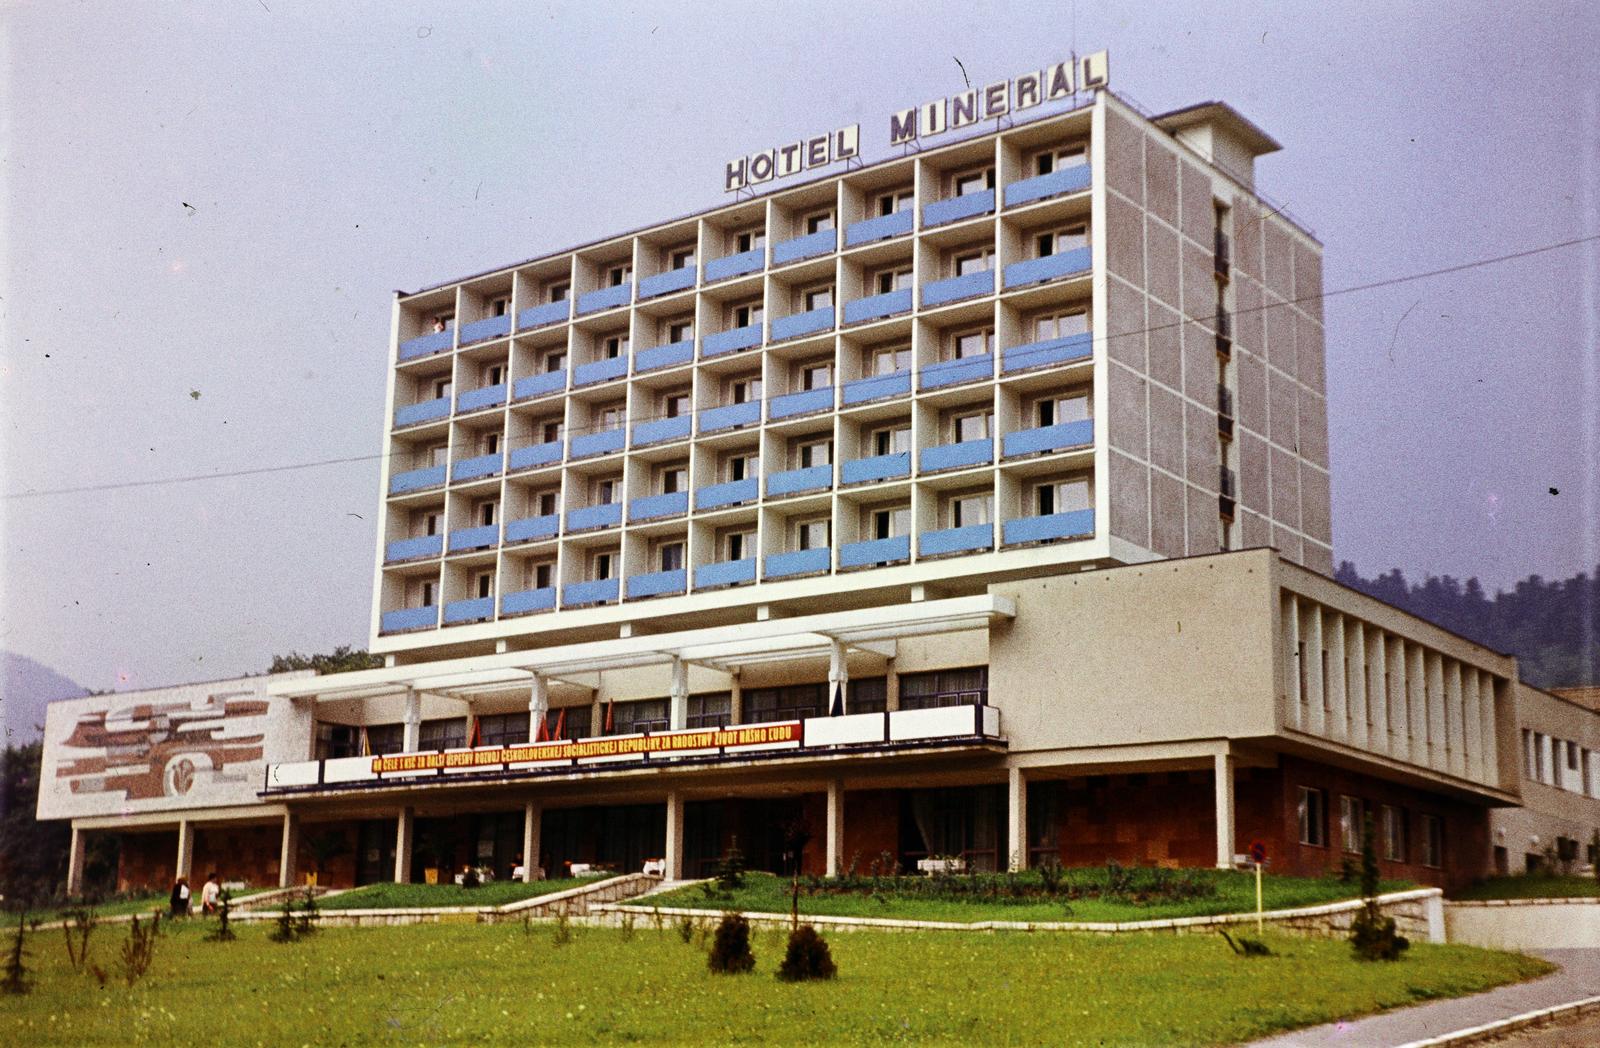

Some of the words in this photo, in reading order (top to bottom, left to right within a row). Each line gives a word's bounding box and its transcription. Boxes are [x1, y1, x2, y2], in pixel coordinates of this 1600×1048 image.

[726, 130, 854, 189] HOTEL
[475, 750, 500, 764] ROZVOJ
[563, 740, 617, 757] SOCIALISTICKEJ
[662, 736, 671, 749] ZA
